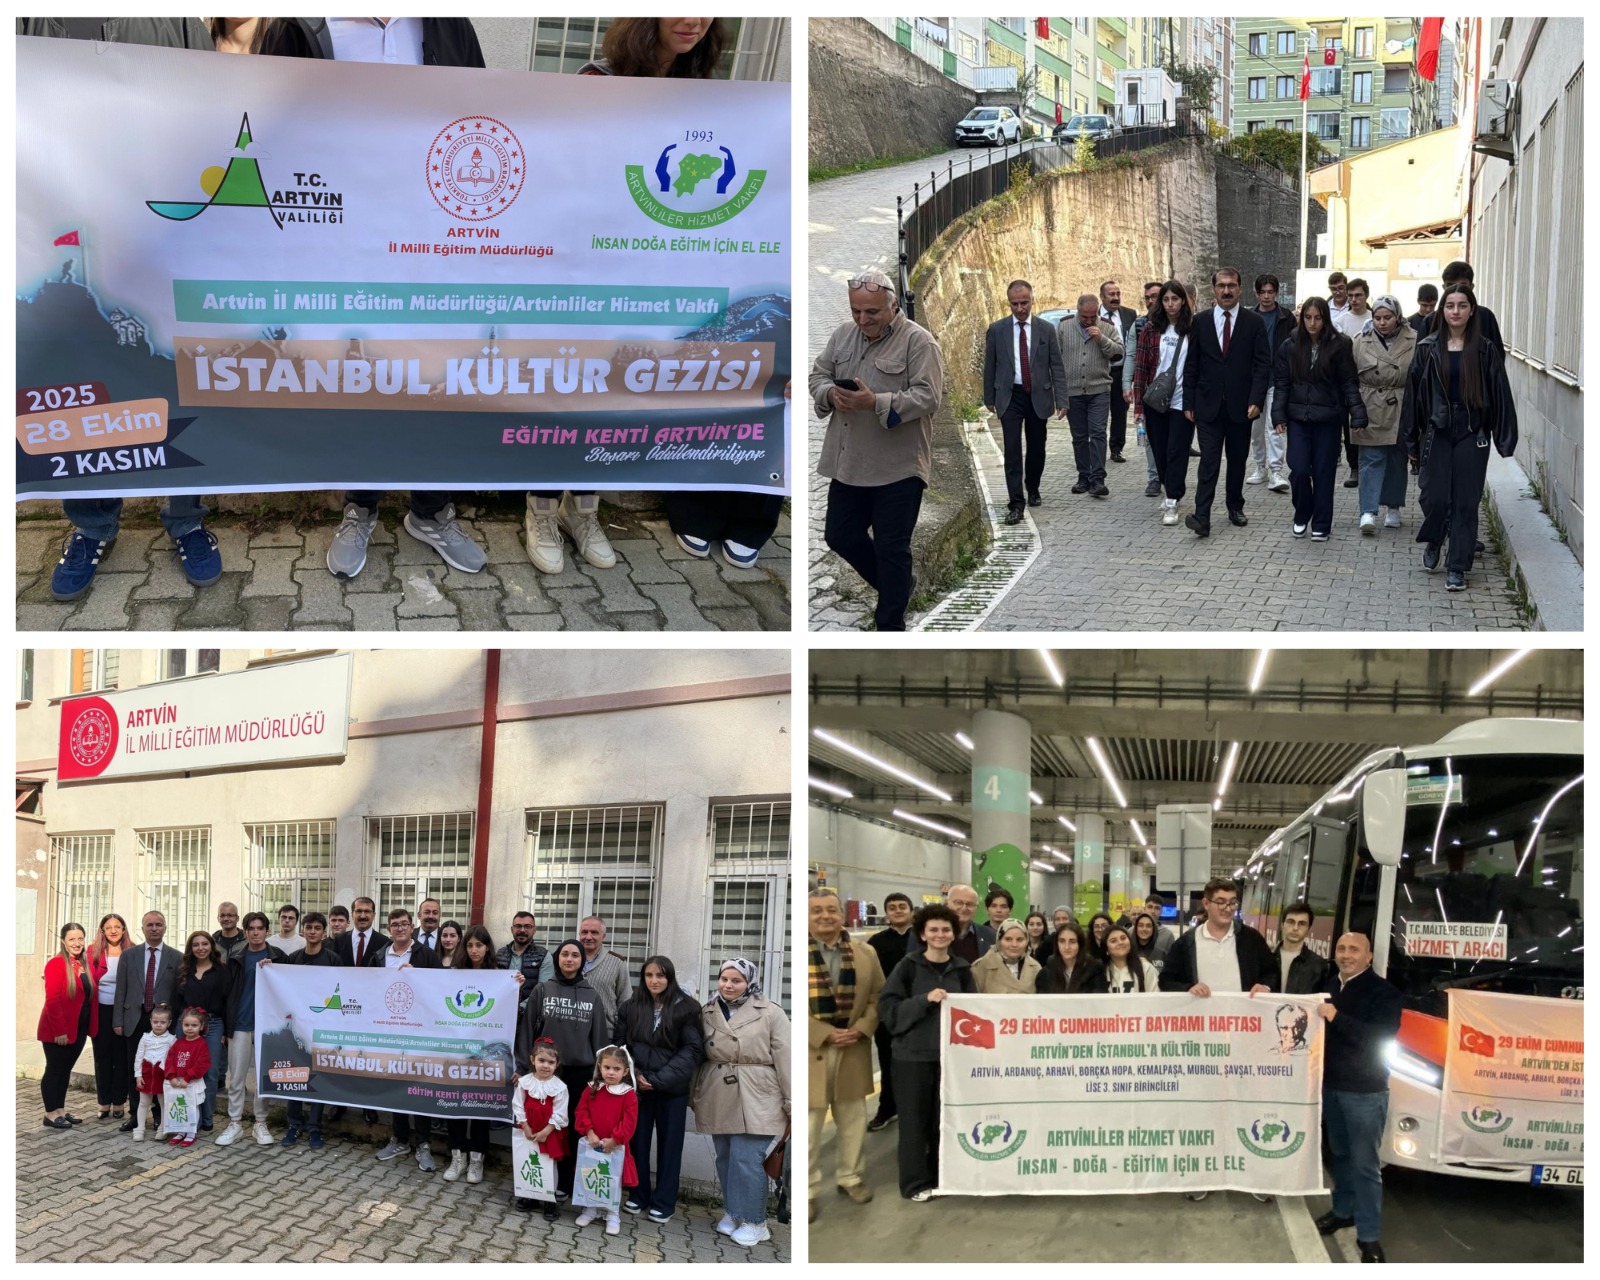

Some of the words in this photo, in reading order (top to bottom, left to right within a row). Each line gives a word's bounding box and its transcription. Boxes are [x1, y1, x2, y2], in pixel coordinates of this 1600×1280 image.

[684, 130, 713, 142] 1993
[293, 173, 327, 187] T.C.
[733, 177, 762, 210] VAKFI
[278, 209, 343, 224] VALİLİĞİ
[446, 226, 500, 239] ARTVİN
[388, 241, 397, 253] İl
[433, 243, 477, 257] Eğitim
[479, 244, 554, 258] Müdürlüğü
[591, 234, 629, 250] İNSAN
[631, 235, 667, 251] DOĞA
[670, 236, 711, 252] EĞİTİM
[713, 237, 739, 255] İÇİN
[741, 241, 756, 253] EL
[758, 241, 781, 254] ELE
[202, 292, 267, 310] Artvin
[293, 293, 337, 310] Milli
[409, 294, 605, 315] Müdürlüğü/Artvinliler
[610, 296, 670, 313] Hizmet
[675, 297, 719, 314] Vakfı
[194, 344, 431, 395] İSTANBUL
[446, 345, 612, 396] KÜLTÜR
[623, 347, 762, 393] GEZİSİ
[26, 384, 96, 412] 2025
[24, 419, 71, 445] 28
[81, 409, 162, 438] Ekim
[502, 425, 578, 445] EĞİTİM
[584, 424, 650, 444] KENTİ
[50, 456, 69, 477] 2
[75, 446, 167, 475] KASIM
[584, 446, 641, 466] Başarı
[645, 441, 766, 466] Ödüllendiriliyor
[126, 702, 178, 729] ARTVİN
[126, 733, 136, 754] İL
[138, 730, 172, 753] MİLLÎ
[175, 725, 221, 749] EĞİTİM
[224, 710, 326, 744] MÜDÜRLÜĞÜ
[983, 775, 1001, 801] 4
[1083, 846, 1092, 858] 3
[1115, 868, 1123, 878] 2
[1407, 936, 1460, 956] HİZMET
[1463, 941, 1504, 958] ARACI
[1000, 1018, 1018, 1035] 29
[1021, 1015, 1055, 1035] EKİM
[1059, 1014, 1142, 1035] CUMHURİYET
[1145, 1015, 1205, 1033] BAYRAMI
[1208, 1015, 1262, 1033] HAFTASI
[1030, 1042, 1093, 1060] ARTVİN'DEN
[1096, 1041, 1158, 1058] İSTANBUL'A
[1161, 1040, 1200, 1057] KÜLTÜR
[1203, 1043, 1231, 1057] TURU
[1498, 1036, 1513, 1048] 29
[1516, 1035, 1542, 1051] EKİM
[1545, 1039, 1584, 1054] CUMHU
[271, 1071, 283, 1079] 28
[286, 1070, 308, 1078] Ekim
[316, 1050, 383, 1073] İSTANBUL
[387, 1057, 444, 1078] KÜLTÜR
[448, 1062, 500, 1081] GEZİSİ
[971, 1065, 1003, 1079] ARTVİN,
[1004, 1066, 1044, 1080] ARDANUÇ,
[1045, 1065, 1078, 1078] ARHAVİ,
[1079, 1065, 1110, 1079] BORÇKA
[1137, 1065, 1186, 1078] KEMALPAŞA,
[1187, 1064, 1223, 1077] MURGUL,
[1224, 1065, 1256, 1078] ŞAVŞAT,
[1257, 1064, 1293, 1077] YUSUFELİ
[276, 1083, 282, 1091] 2
[283, 1083, 308, 1091] KASIM
[407, 1086, 433, 1097] EĞİTİM
[435, 1090, 460, 1099] KENTİ
[1086, 1080, 1101, 1093] LİSE
[1103, 1082, 1110, 1093] 3.
[1112, 1081, 1132, 1093] SINIF
[1134, 1080, 1179, 1092] BİRİNCİLERİ
[1046, 1126, 1124, 1147] ARTVİNLİLER
[1128, 1126, 1175, 1146] HİZMET
[1178, 1129, 1215, 1146] VAKFI
[1503, 1134, 1534, 1149] İNSAN
[1544, 1138, 1570, 1152] DOĞA
[1017, 1157, 1058, 1175] İNSAN
[1073, 1155, 1107, 1173] DOĞA
[1123, 1154, 1169, 1173] EĞİTİM
[1173, 1154, 1200, 1177] İÇİN
[1205, 1156, 1219, 1172] EL
[1223, 1155, 1246, 1172] ELE
[1543, 1168, 1560, 1183] 34
